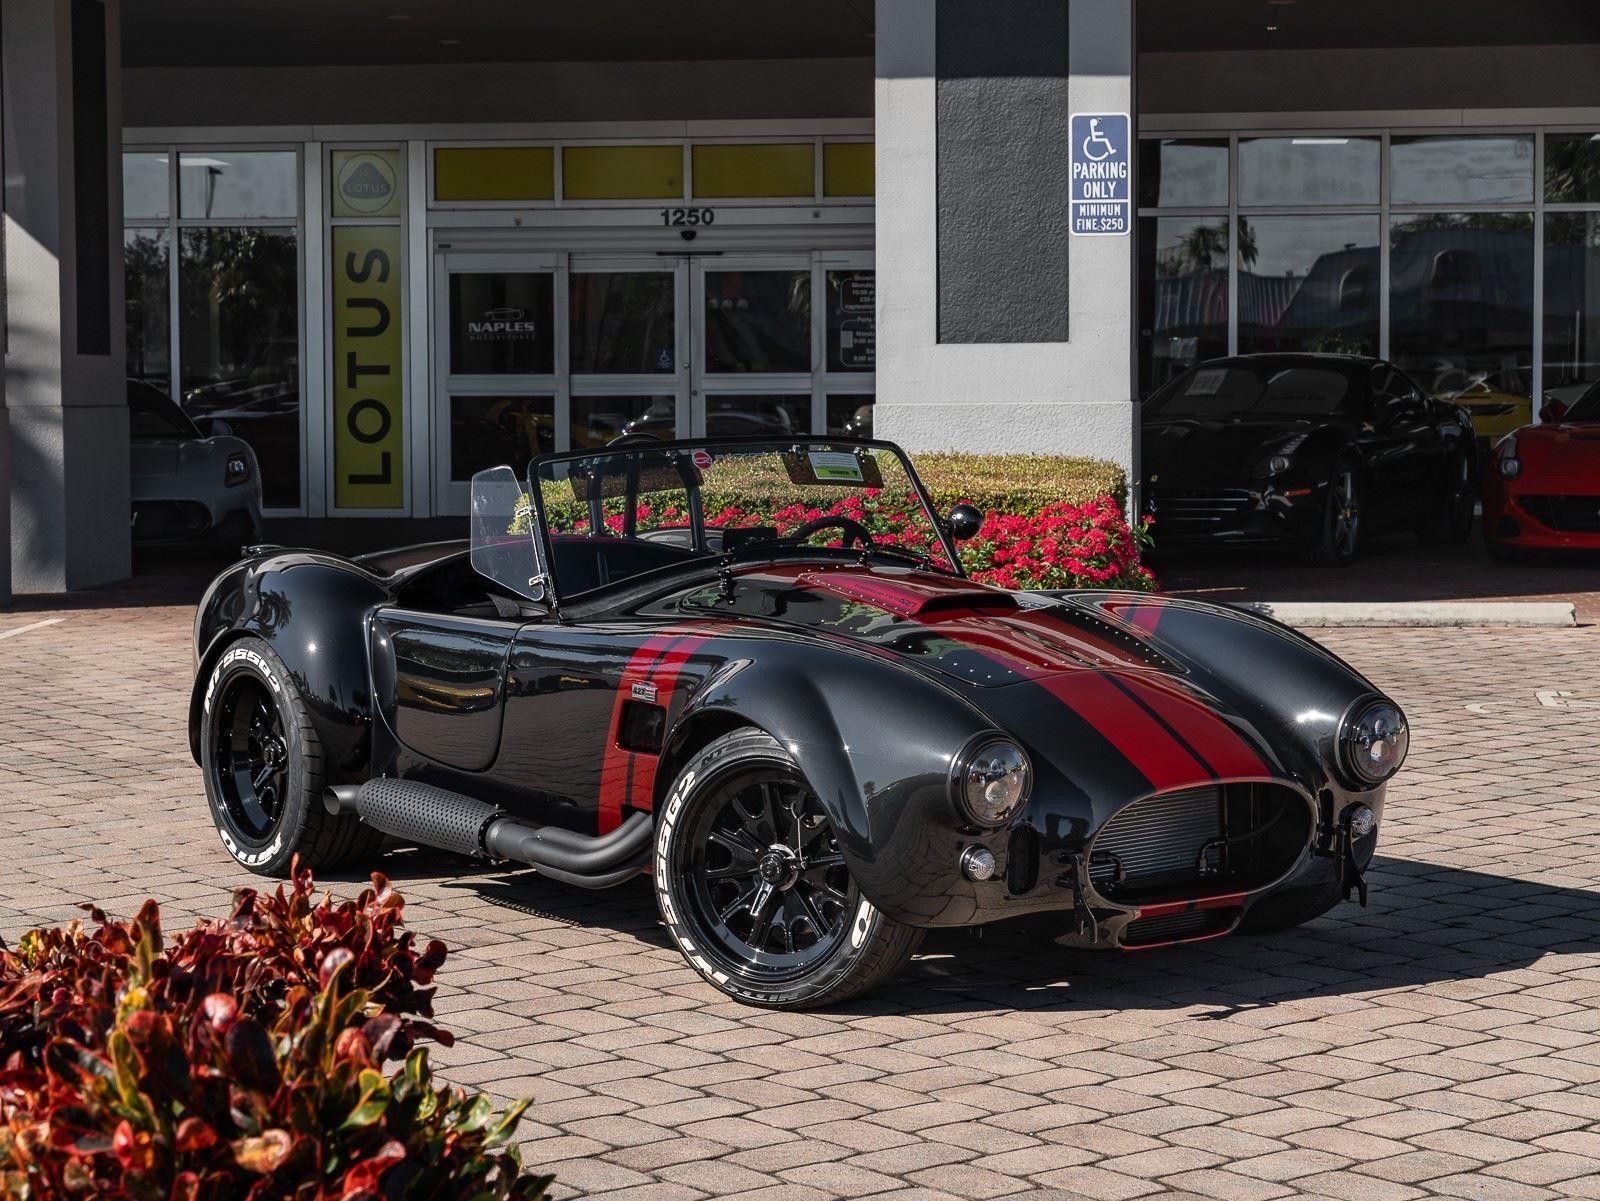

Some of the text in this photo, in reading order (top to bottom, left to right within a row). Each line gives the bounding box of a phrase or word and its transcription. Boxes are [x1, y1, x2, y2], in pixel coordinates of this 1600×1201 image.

[1073, 162, 1127, 179] PARKING
[347, 183, 389, 193] LOTUS
[1083, 181, 1117, 198] ONLY
[660, 208, 714, 226] 1250
[1079, 204, 1121, 216] MINIMUM
[1077, 218, 1124, 231] FINE $250
[468, 321, 536, 333] NAPLES
[346, 249, 391, 485] LOTUS
[219, 829, 283, 866] NITTO
[654, 771, 731, 987] NT555G2
